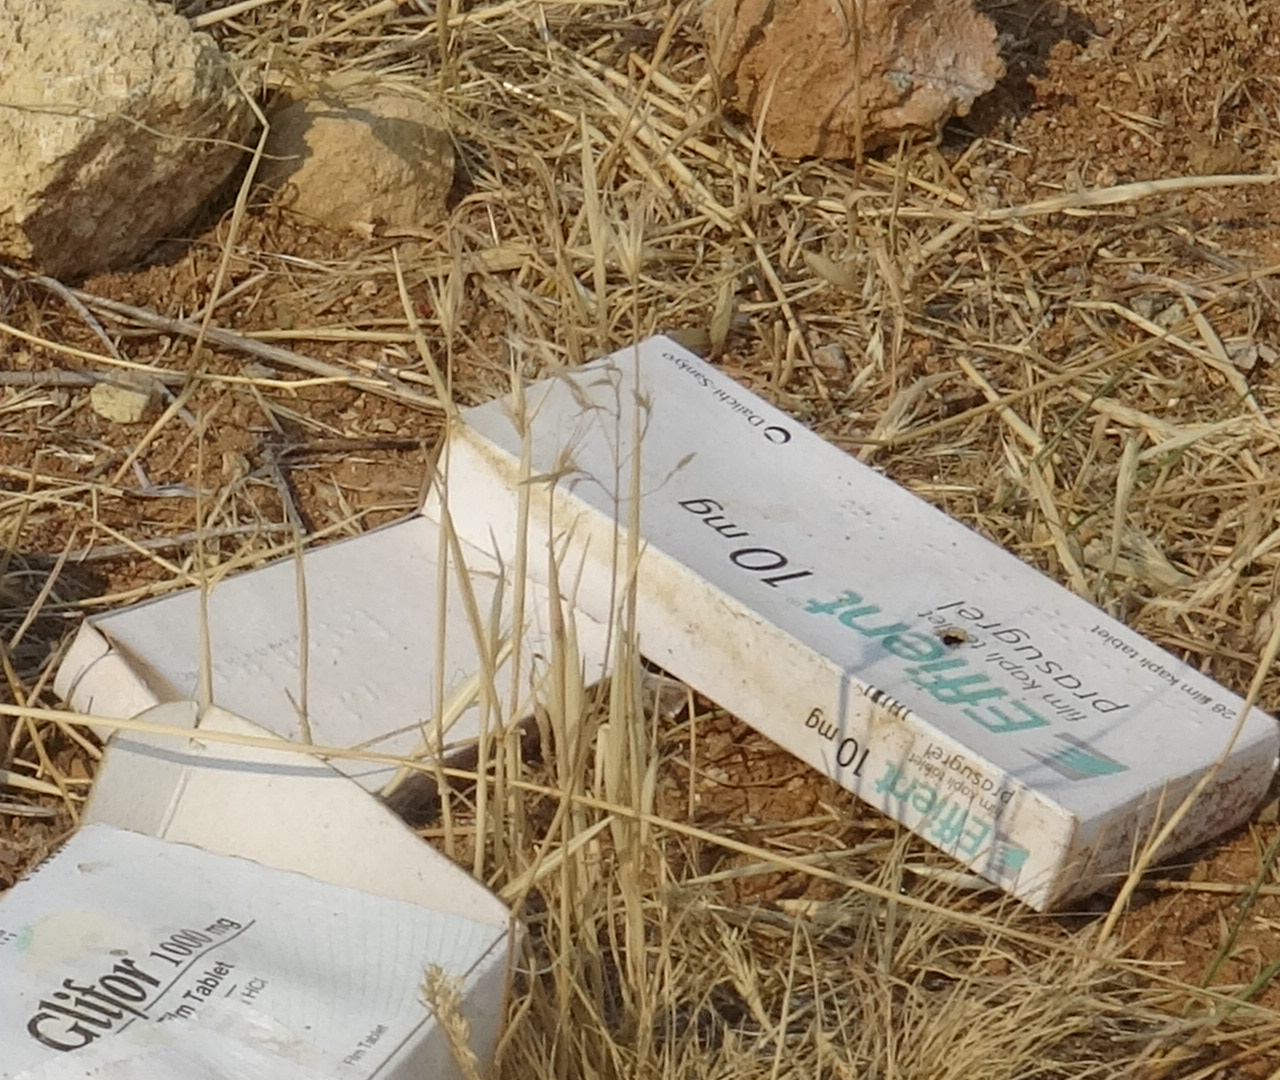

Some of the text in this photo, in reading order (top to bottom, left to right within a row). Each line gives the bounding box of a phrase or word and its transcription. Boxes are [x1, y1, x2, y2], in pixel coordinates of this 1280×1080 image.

[678, 497, 1051, 735] Effient 10 mg
[937, 600, 1131, 716] prasugrel
[1090, 624, 1140, 660] tablet
[984, 650, 1044, 694] kaplı
[1041, 692, 1088, 723] film
[1211, 702, 1238, 721] 28
[804, 707, 992, 857] Effient 10 mg
[26, 916, 242, 1053] Glifor 1000 mg
[183, 959, 236, 1005] Tablet
